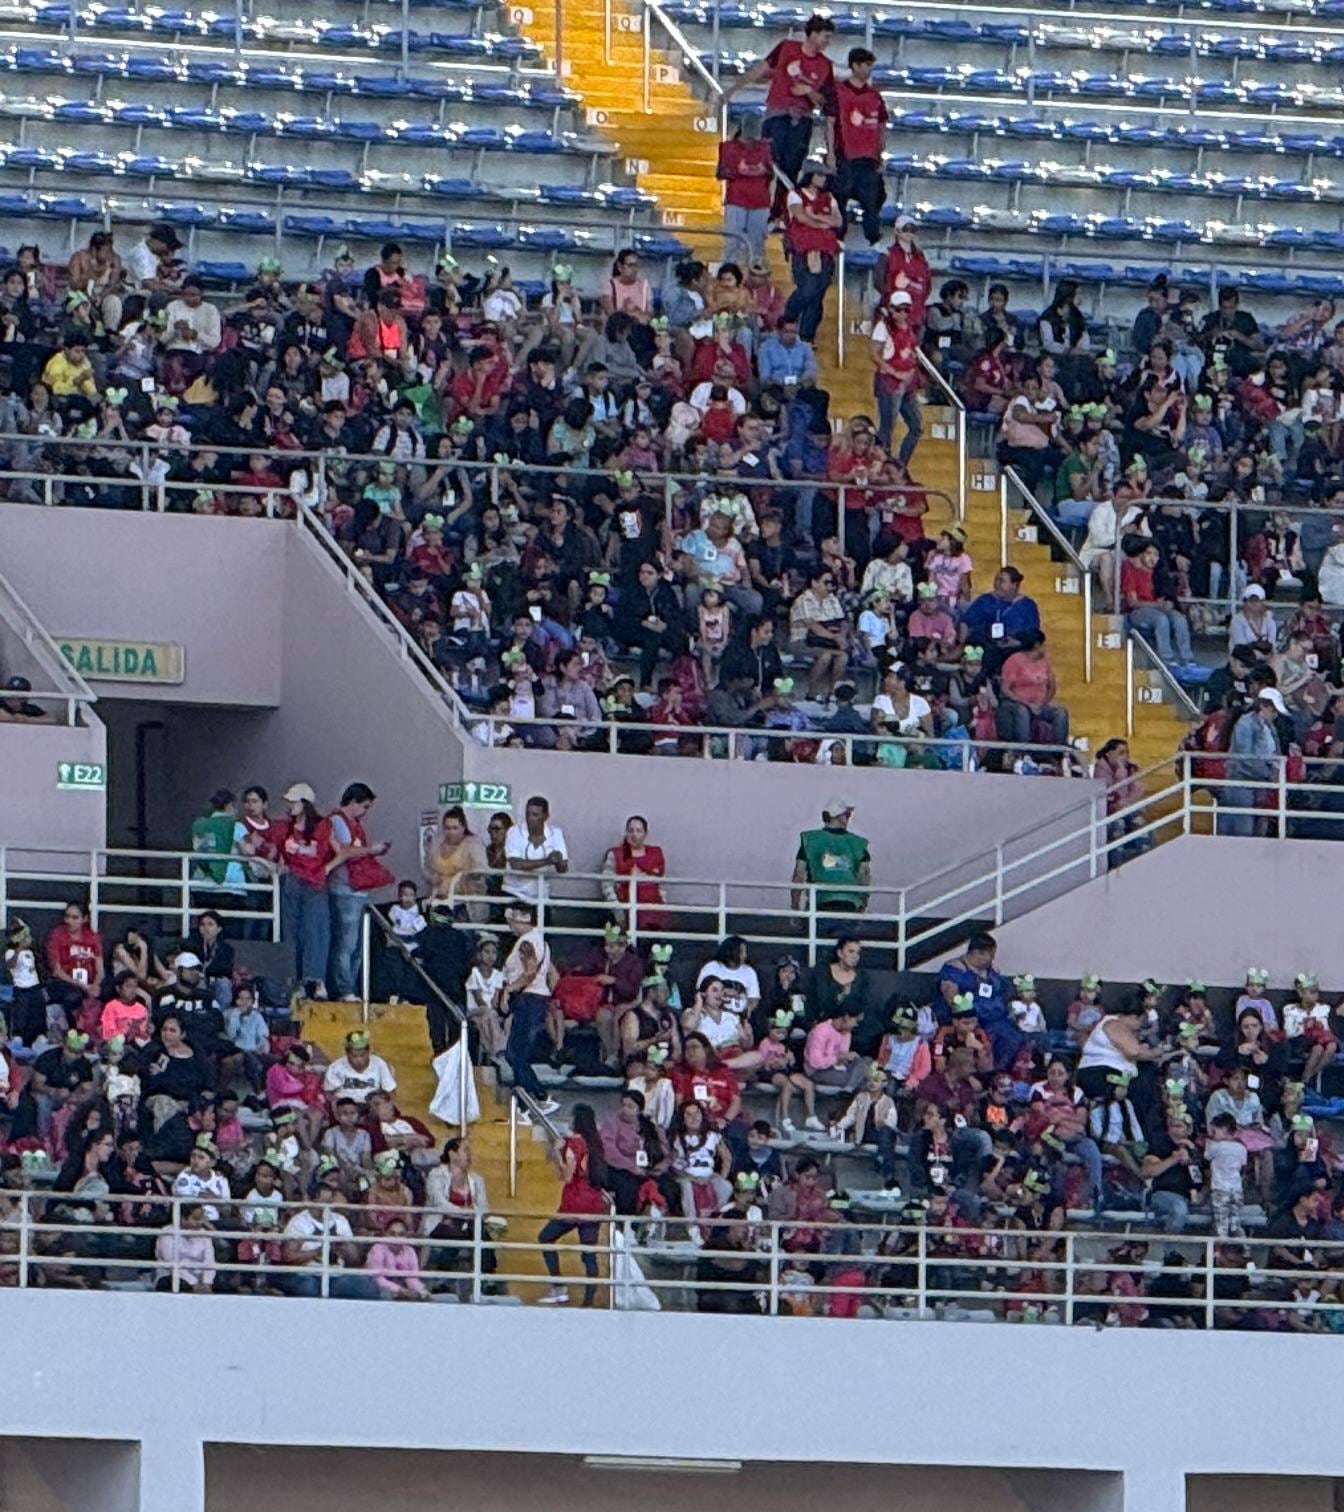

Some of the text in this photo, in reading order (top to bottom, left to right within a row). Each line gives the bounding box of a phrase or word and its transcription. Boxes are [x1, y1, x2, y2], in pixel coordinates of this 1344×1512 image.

[61, 643, 157, 675] SALIDA
[74, 765, 102, 783] E22
[480, 784, 507, 803] E22
